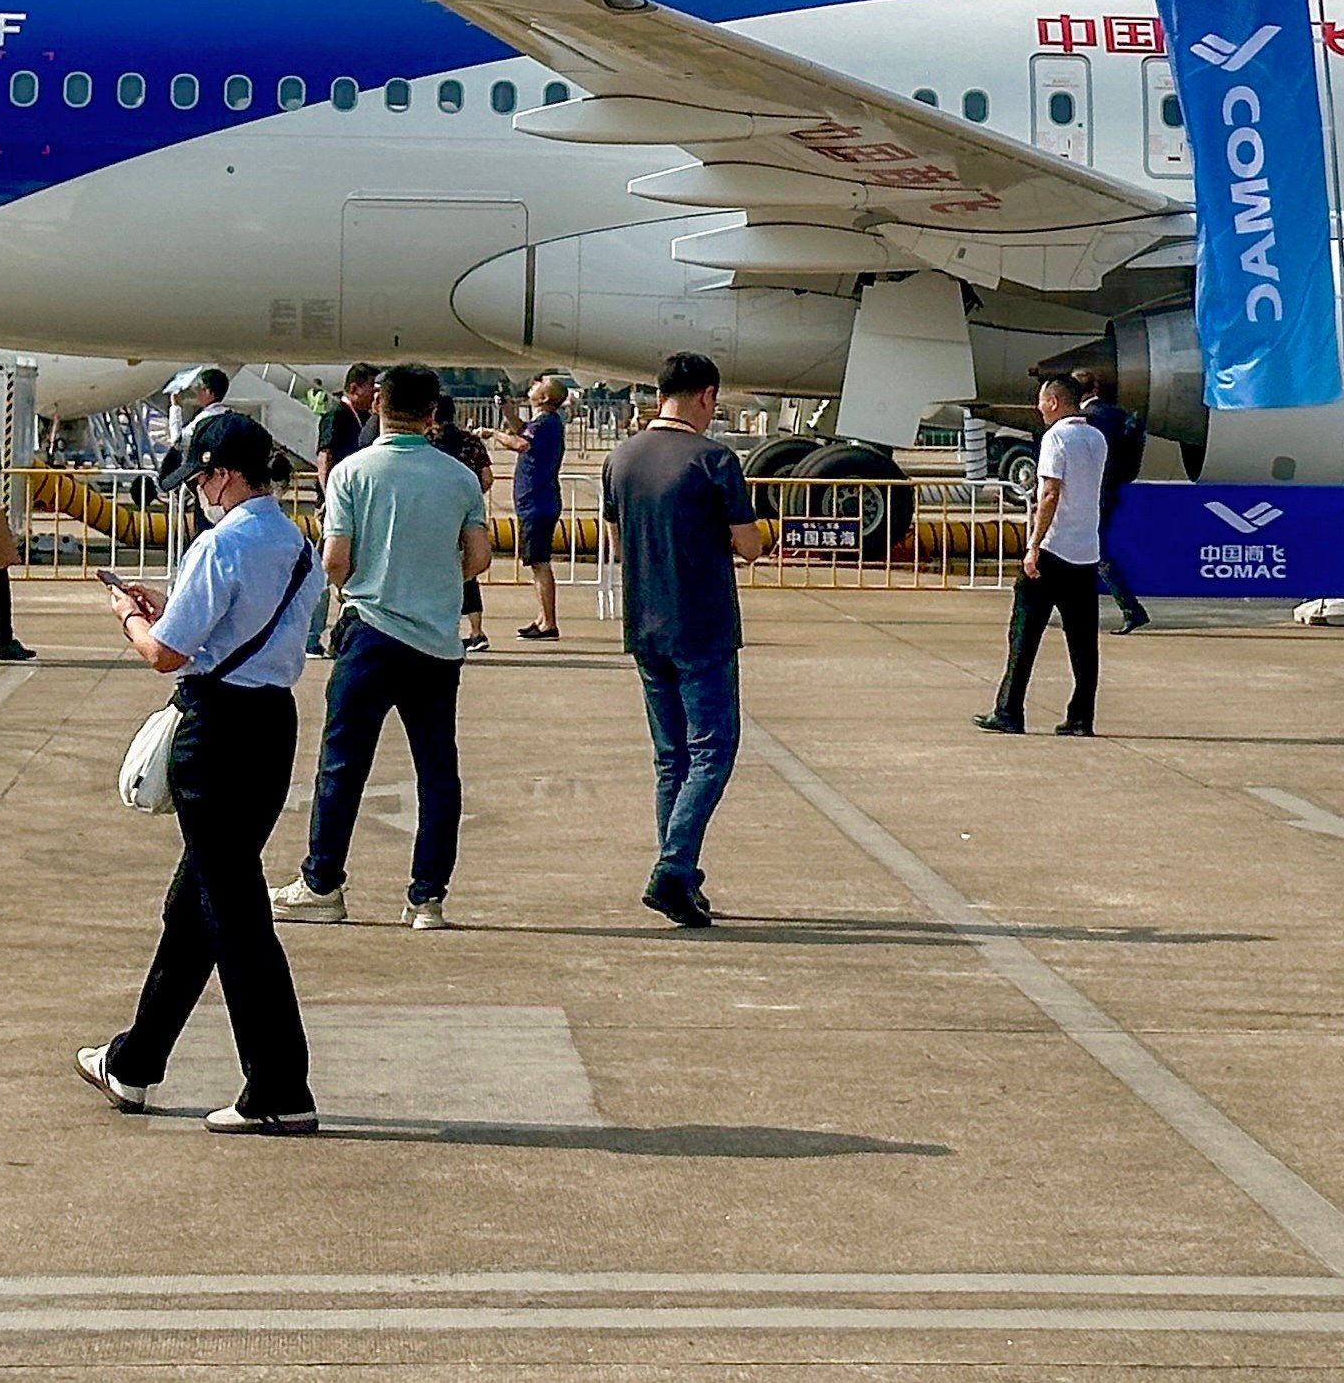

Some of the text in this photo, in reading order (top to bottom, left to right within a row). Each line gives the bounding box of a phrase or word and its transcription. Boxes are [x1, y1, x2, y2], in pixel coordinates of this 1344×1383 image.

[786, 528, 856, 547] 中国珠海
[1200, 544, 1287, 563] 中国商飞
[1200, 564, 1287, 579] COMAC
